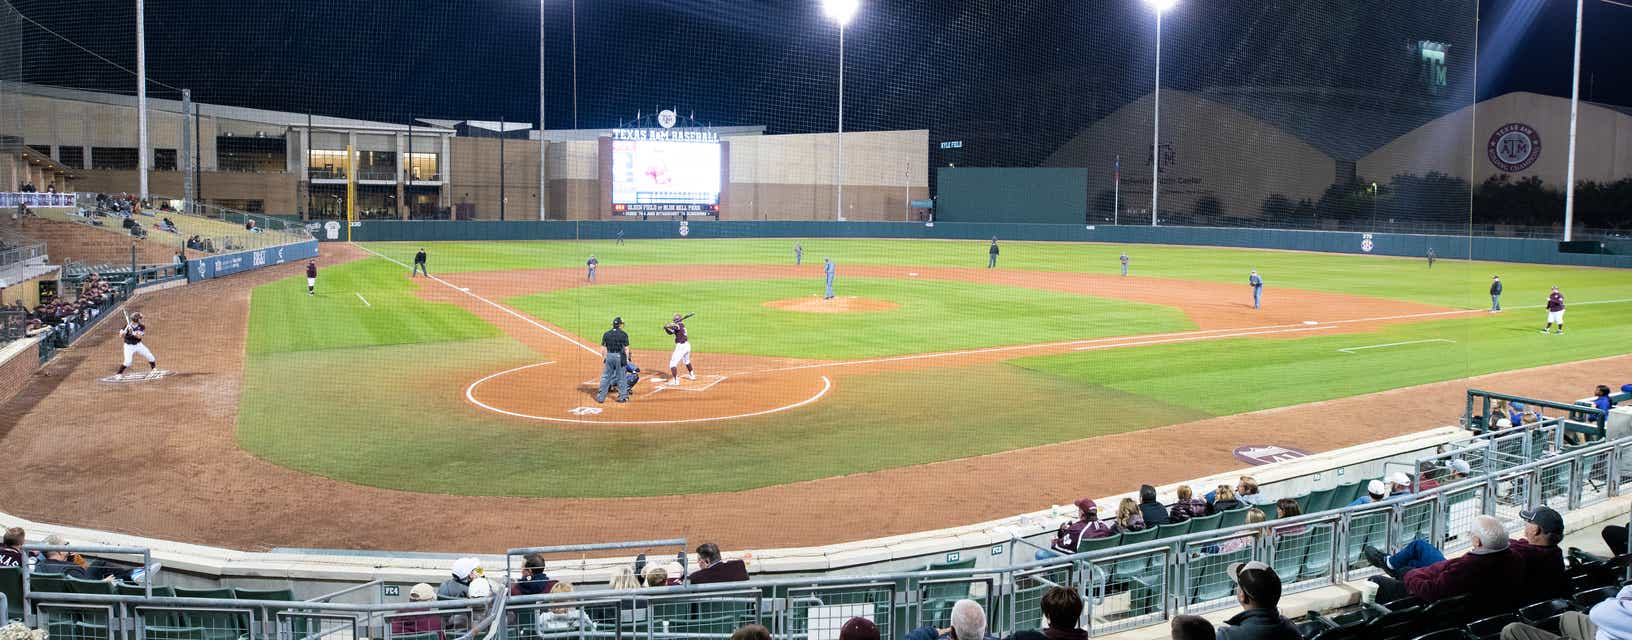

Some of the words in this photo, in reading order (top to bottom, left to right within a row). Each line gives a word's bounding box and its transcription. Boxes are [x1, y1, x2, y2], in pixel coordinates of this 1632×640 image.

[613, 128, 647, 140] TEXAS
[649, 130, 669, 141] A&M
[672, 131, 720, 143] BASEBALL
[951, 140, 962, 148] FIELD
